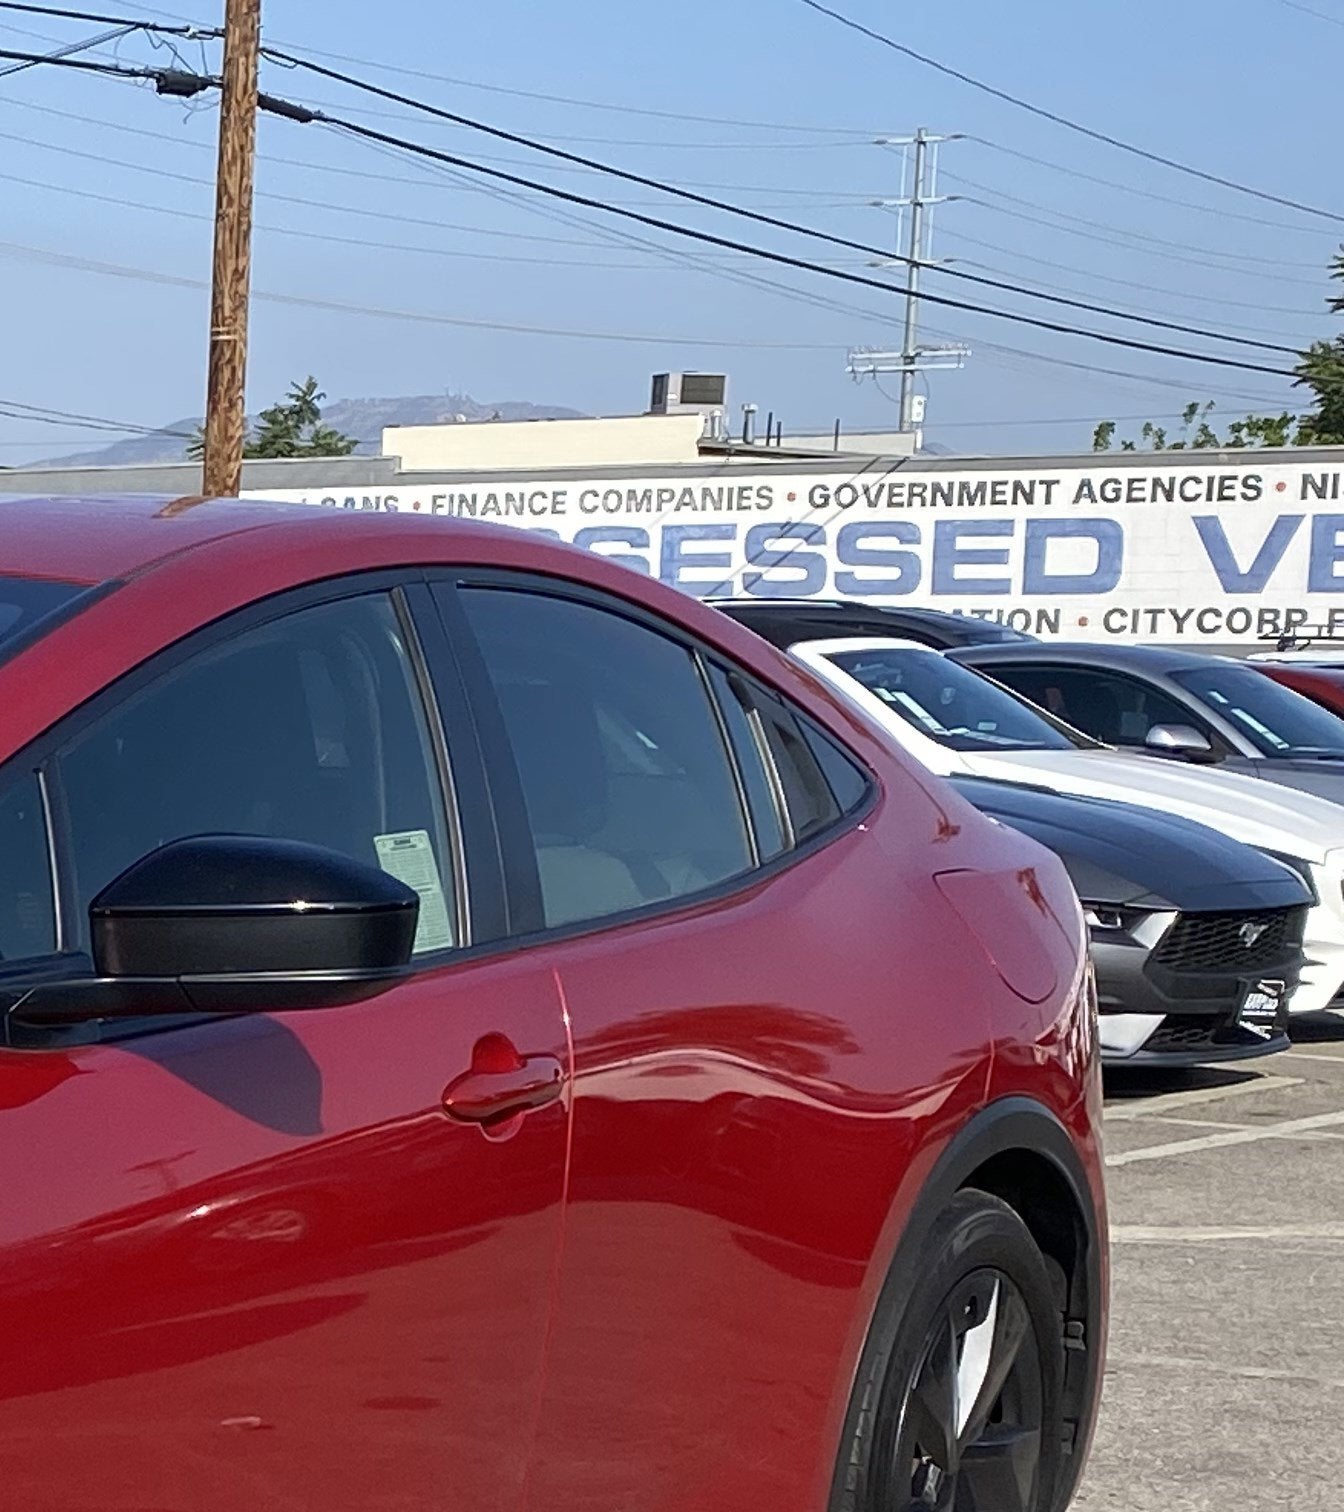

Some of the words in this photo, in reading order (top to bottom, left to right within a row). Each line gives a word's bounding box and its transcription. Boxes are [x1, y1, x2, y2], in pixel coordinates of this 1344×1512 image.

[431, 489, 568, 517] FINANCE
[577, 485, 774, 514] COMPANIES
[808, 478, 1061, 509] GOVERNMENT
[1072, 474, 1263, 506] AGENCIES
[1300, 472, 1344, 501] NI
[525, 518, 1124, 597] SESSED
[1102, 606, 1308, 634] CITYCORP
